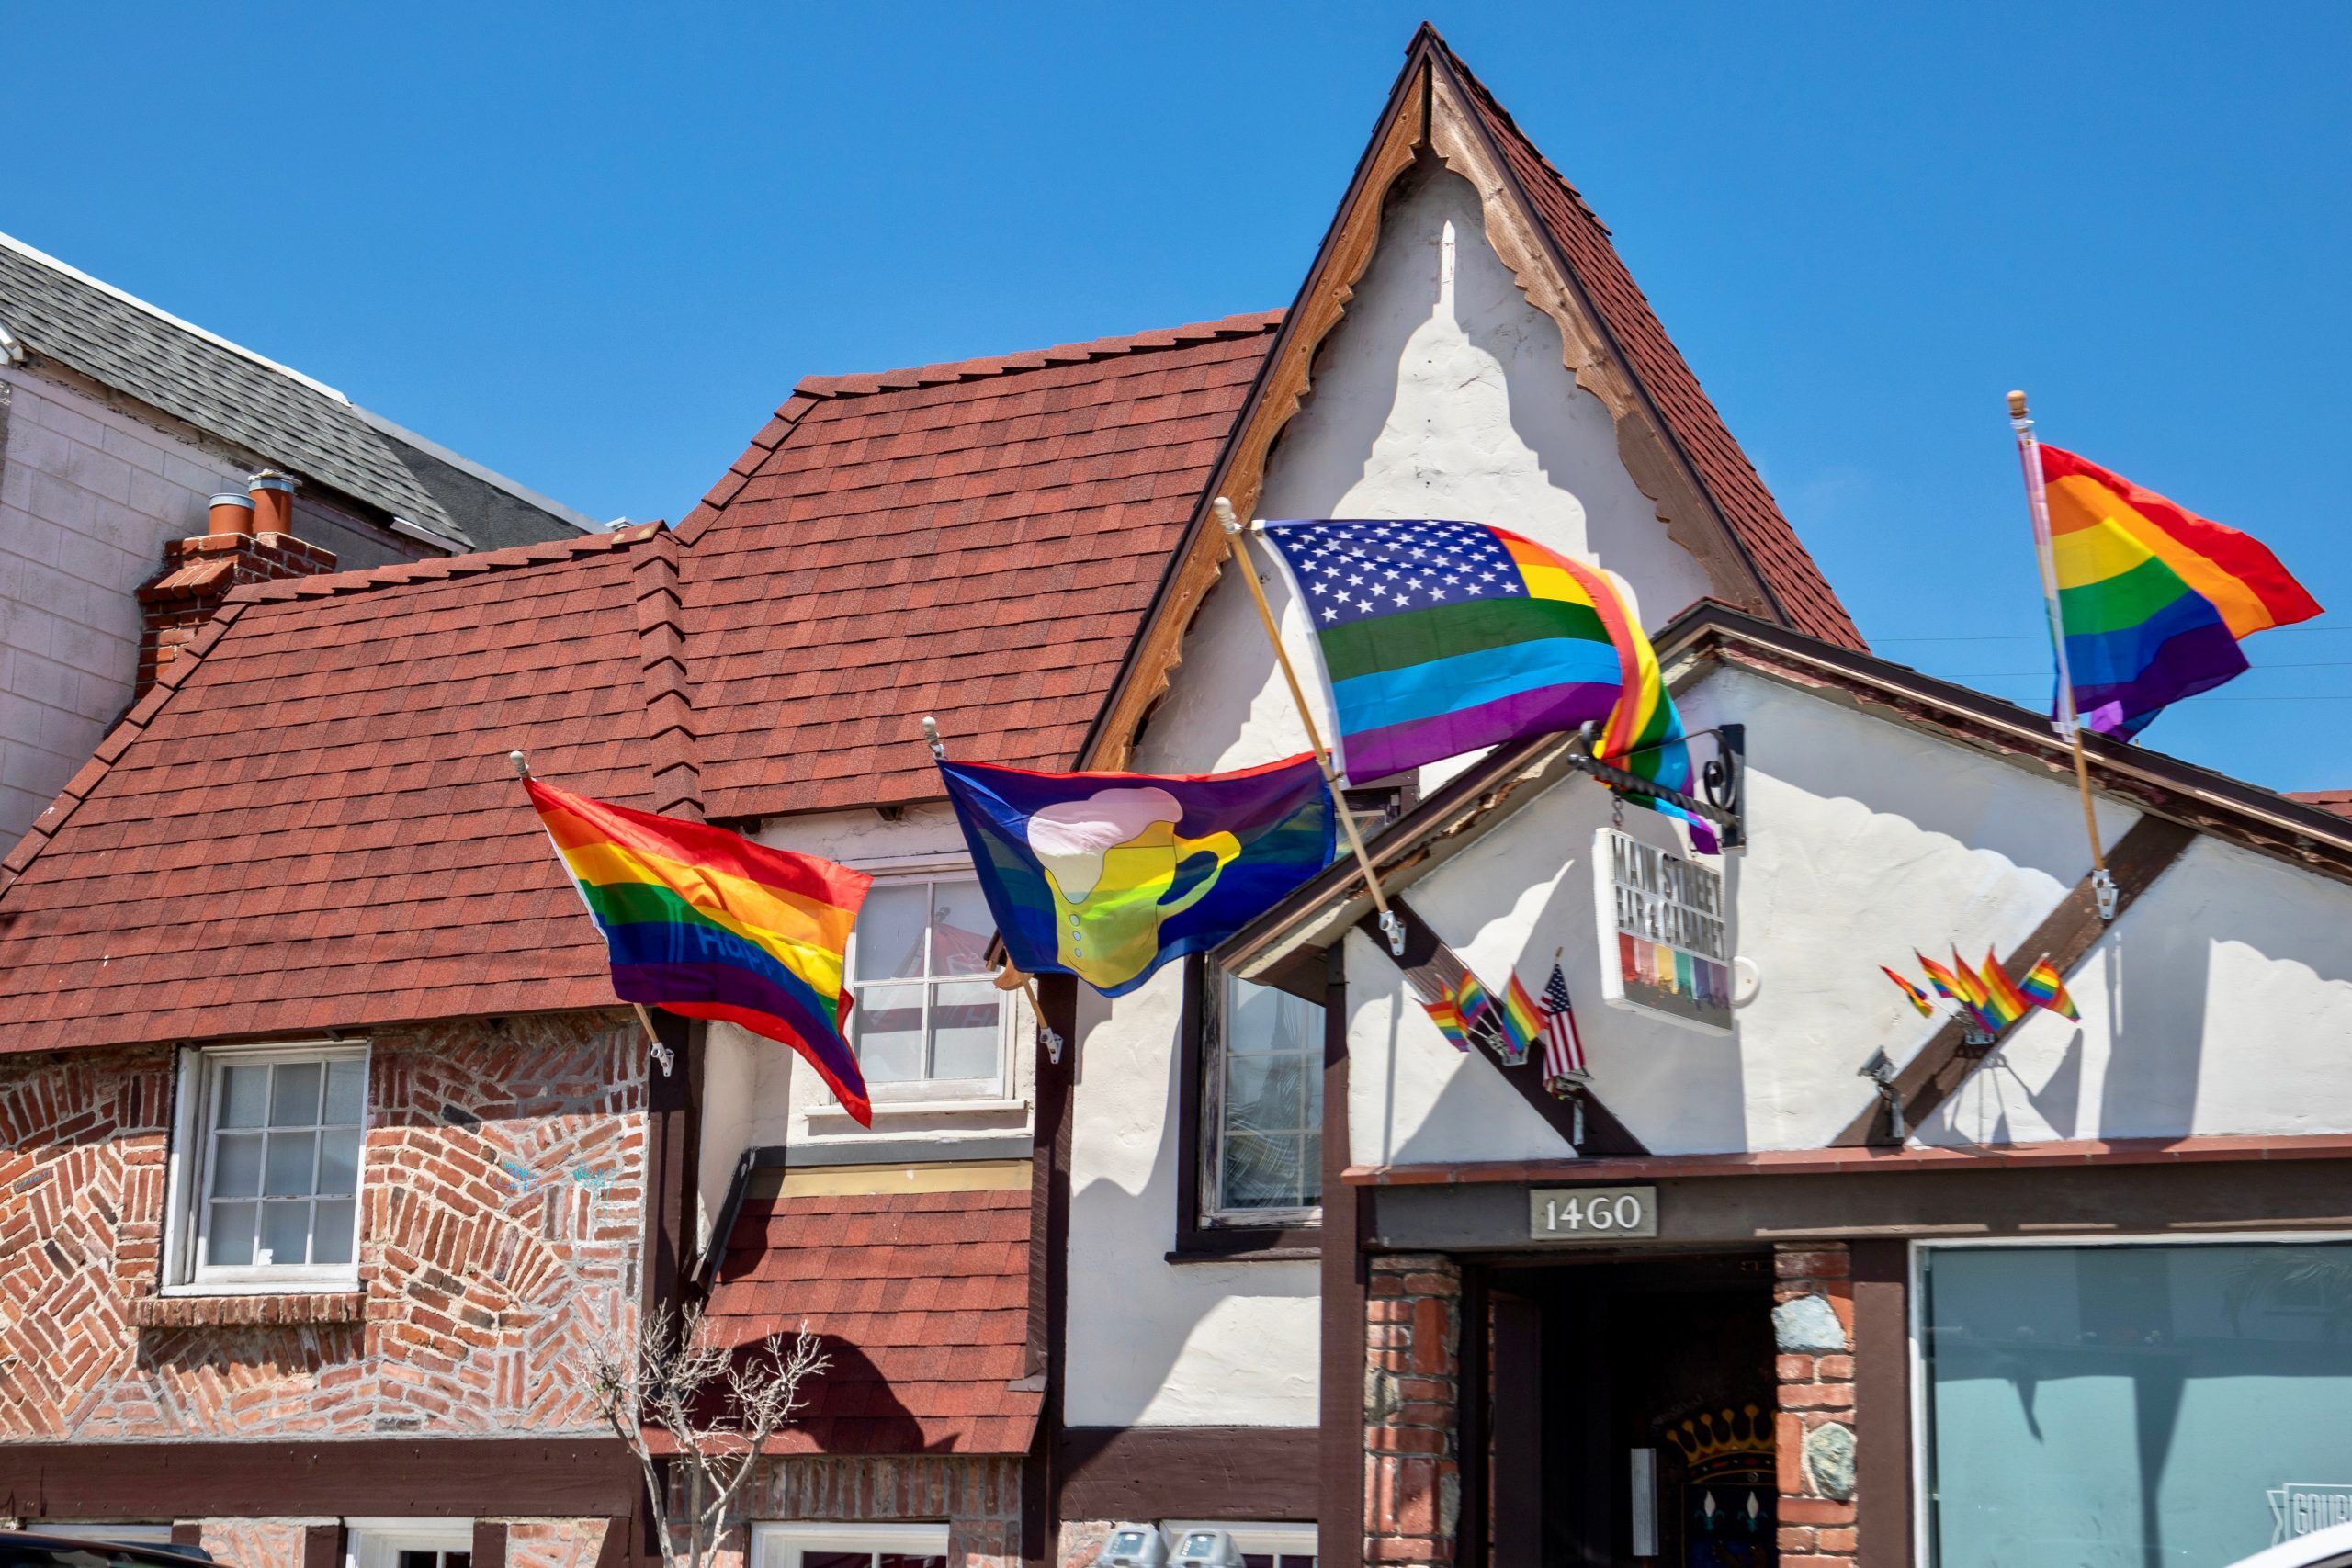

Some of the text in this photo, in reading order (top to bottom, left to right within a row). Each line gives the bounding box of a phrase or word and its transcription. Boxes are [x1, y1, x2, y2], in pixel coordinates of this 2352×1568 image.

[1611, 834, 1721, 918] MAIN STREET
[1616, 885, 1646, 934] BAR
[1546, 1195, 1642, 1230] 1460
[2293, 1493, 2352, 1535] GOUR
